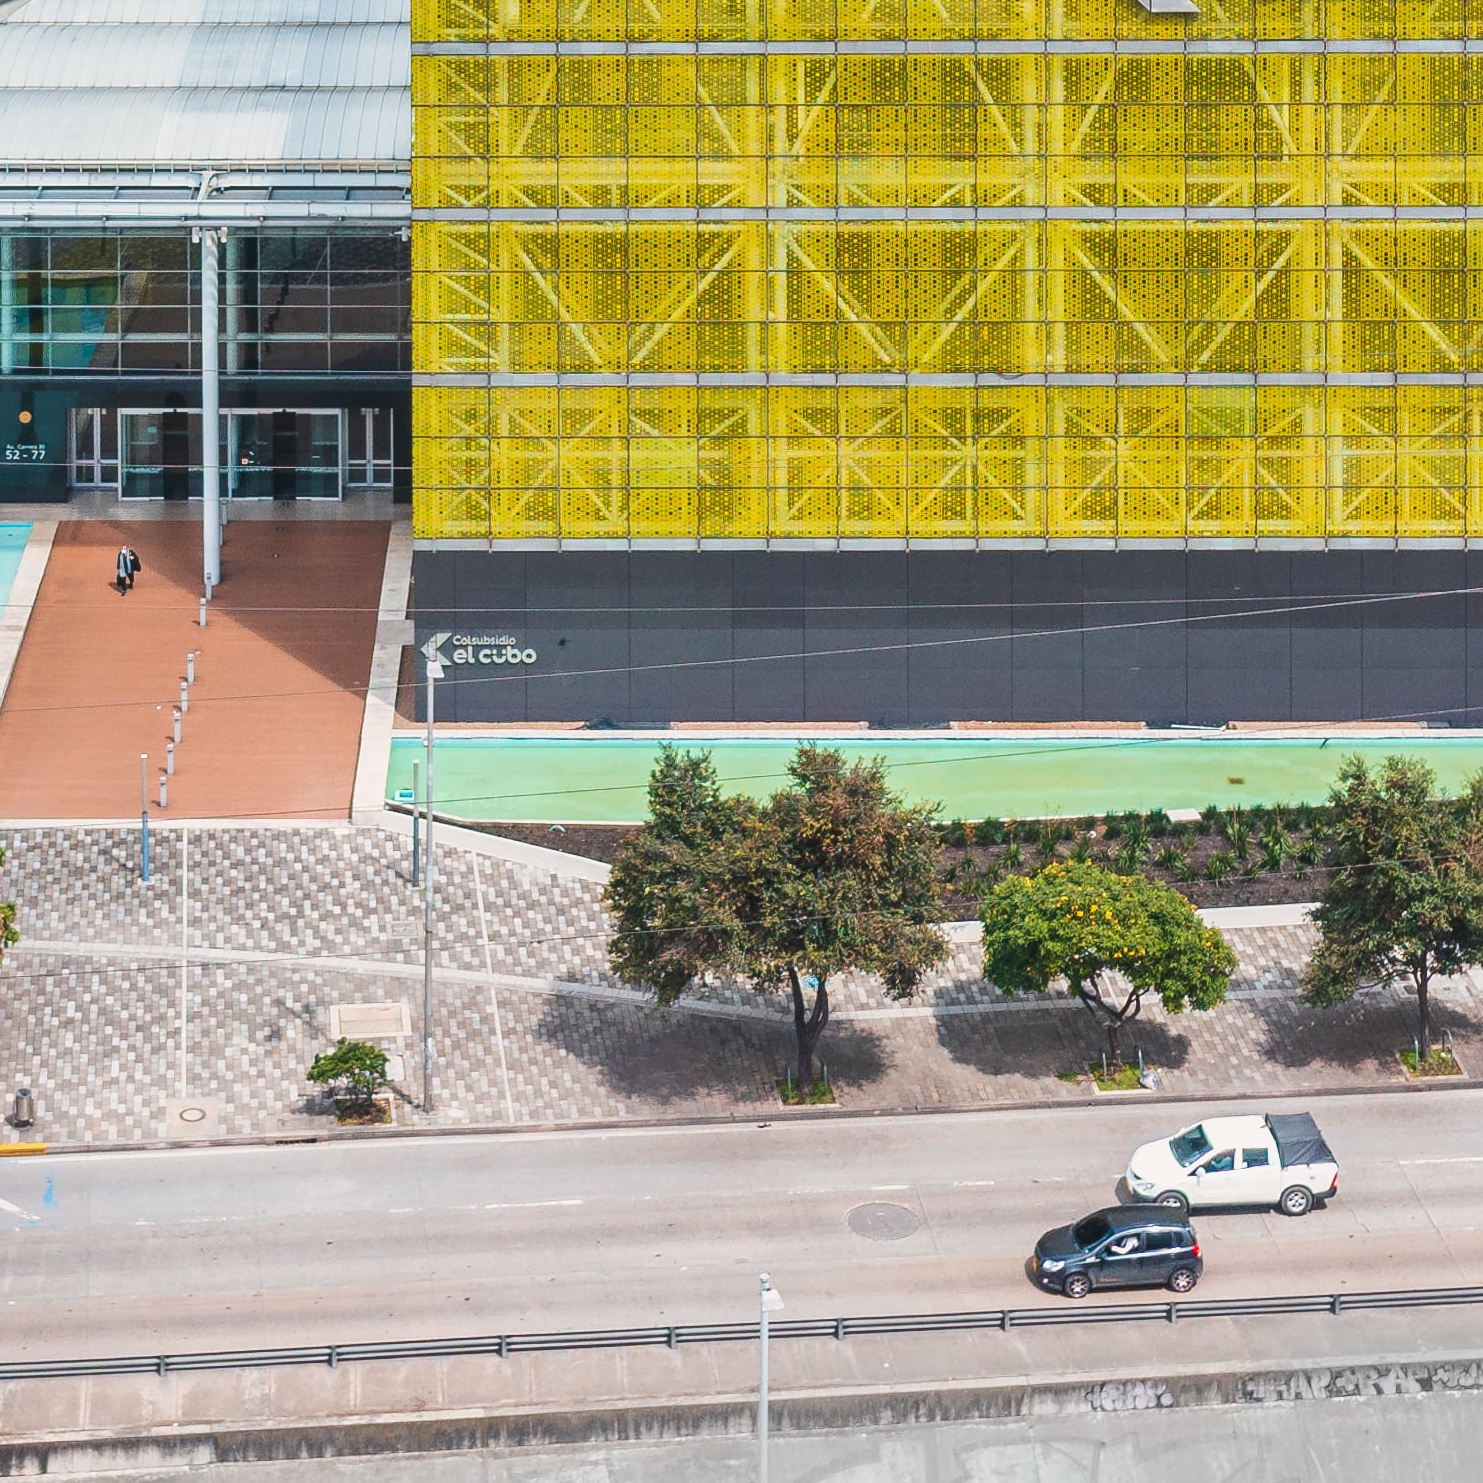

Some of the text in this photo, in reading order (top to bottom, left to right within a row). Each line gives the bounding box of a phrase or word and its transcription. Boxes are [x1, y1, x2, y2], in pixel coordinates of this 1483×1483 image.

[5, 450, 21, 460] 52
[31, 450, 46, 460] 77
[452, 634, 517, 646] Colsubsidio
[452, 645, 538, 665] el cubo
